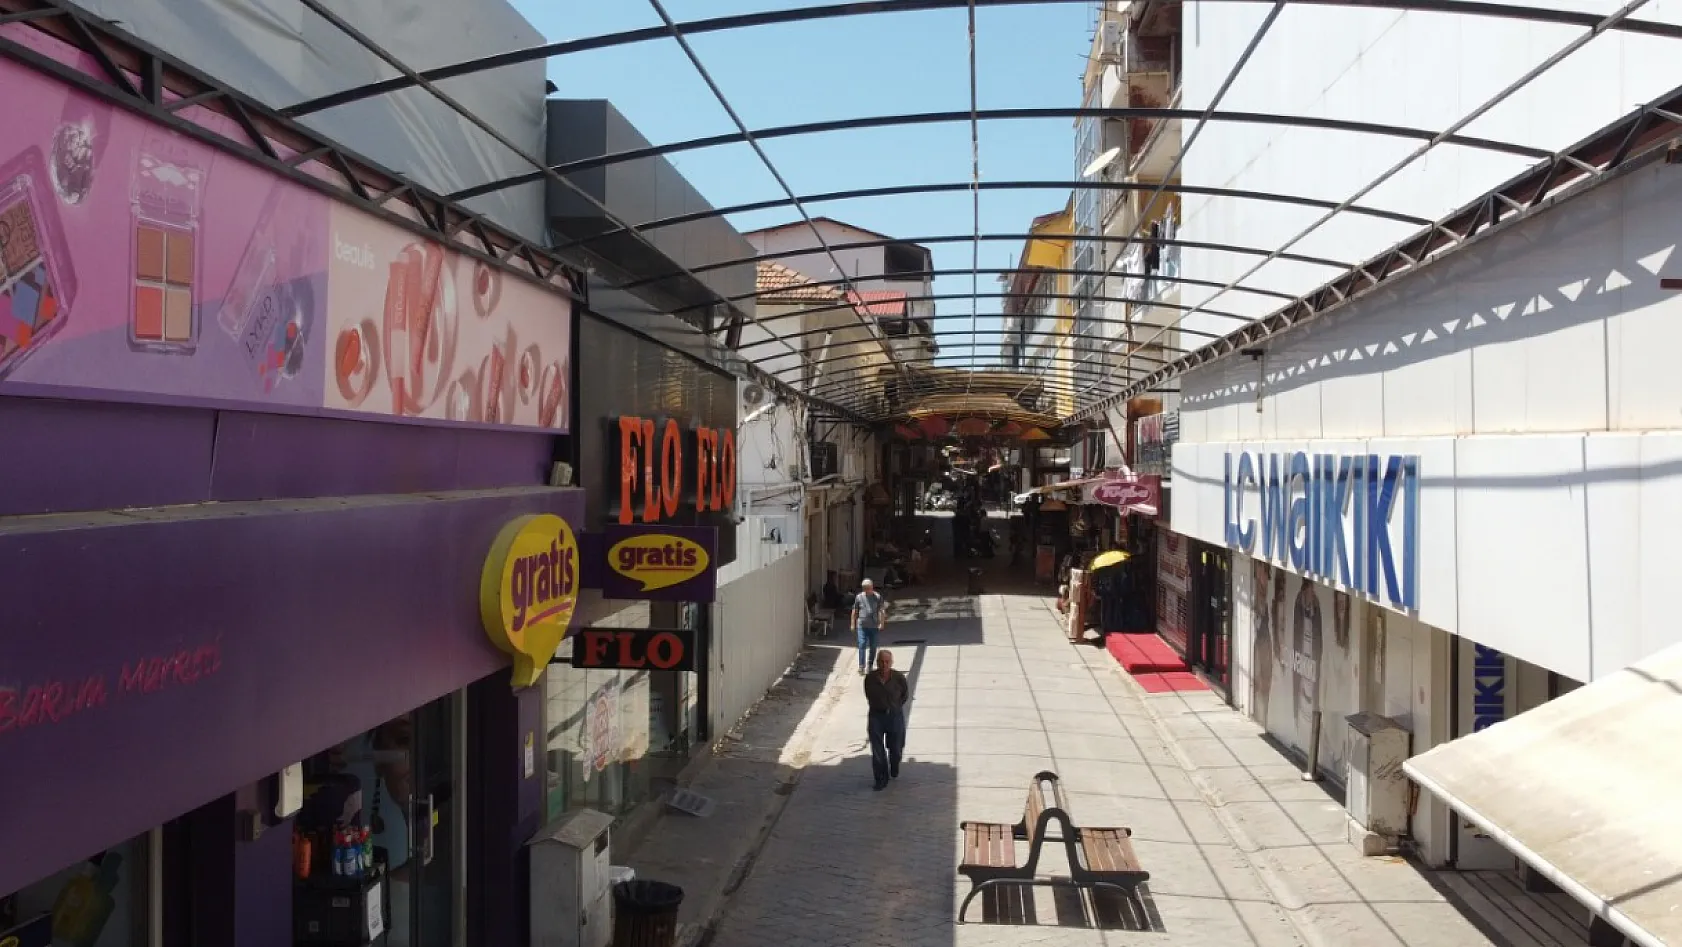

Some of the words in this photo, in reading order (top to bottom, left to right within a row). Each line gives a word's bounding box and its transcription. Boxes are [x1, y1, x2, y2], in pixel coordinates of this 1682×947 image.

[618, 415, 682, 525] FLO
[695, 426, 735, 514] FLO
[511, 529, 574, 630] gratis
[618, 541, 697, 570] gratis
[582, 630, 685, 669] FLO
